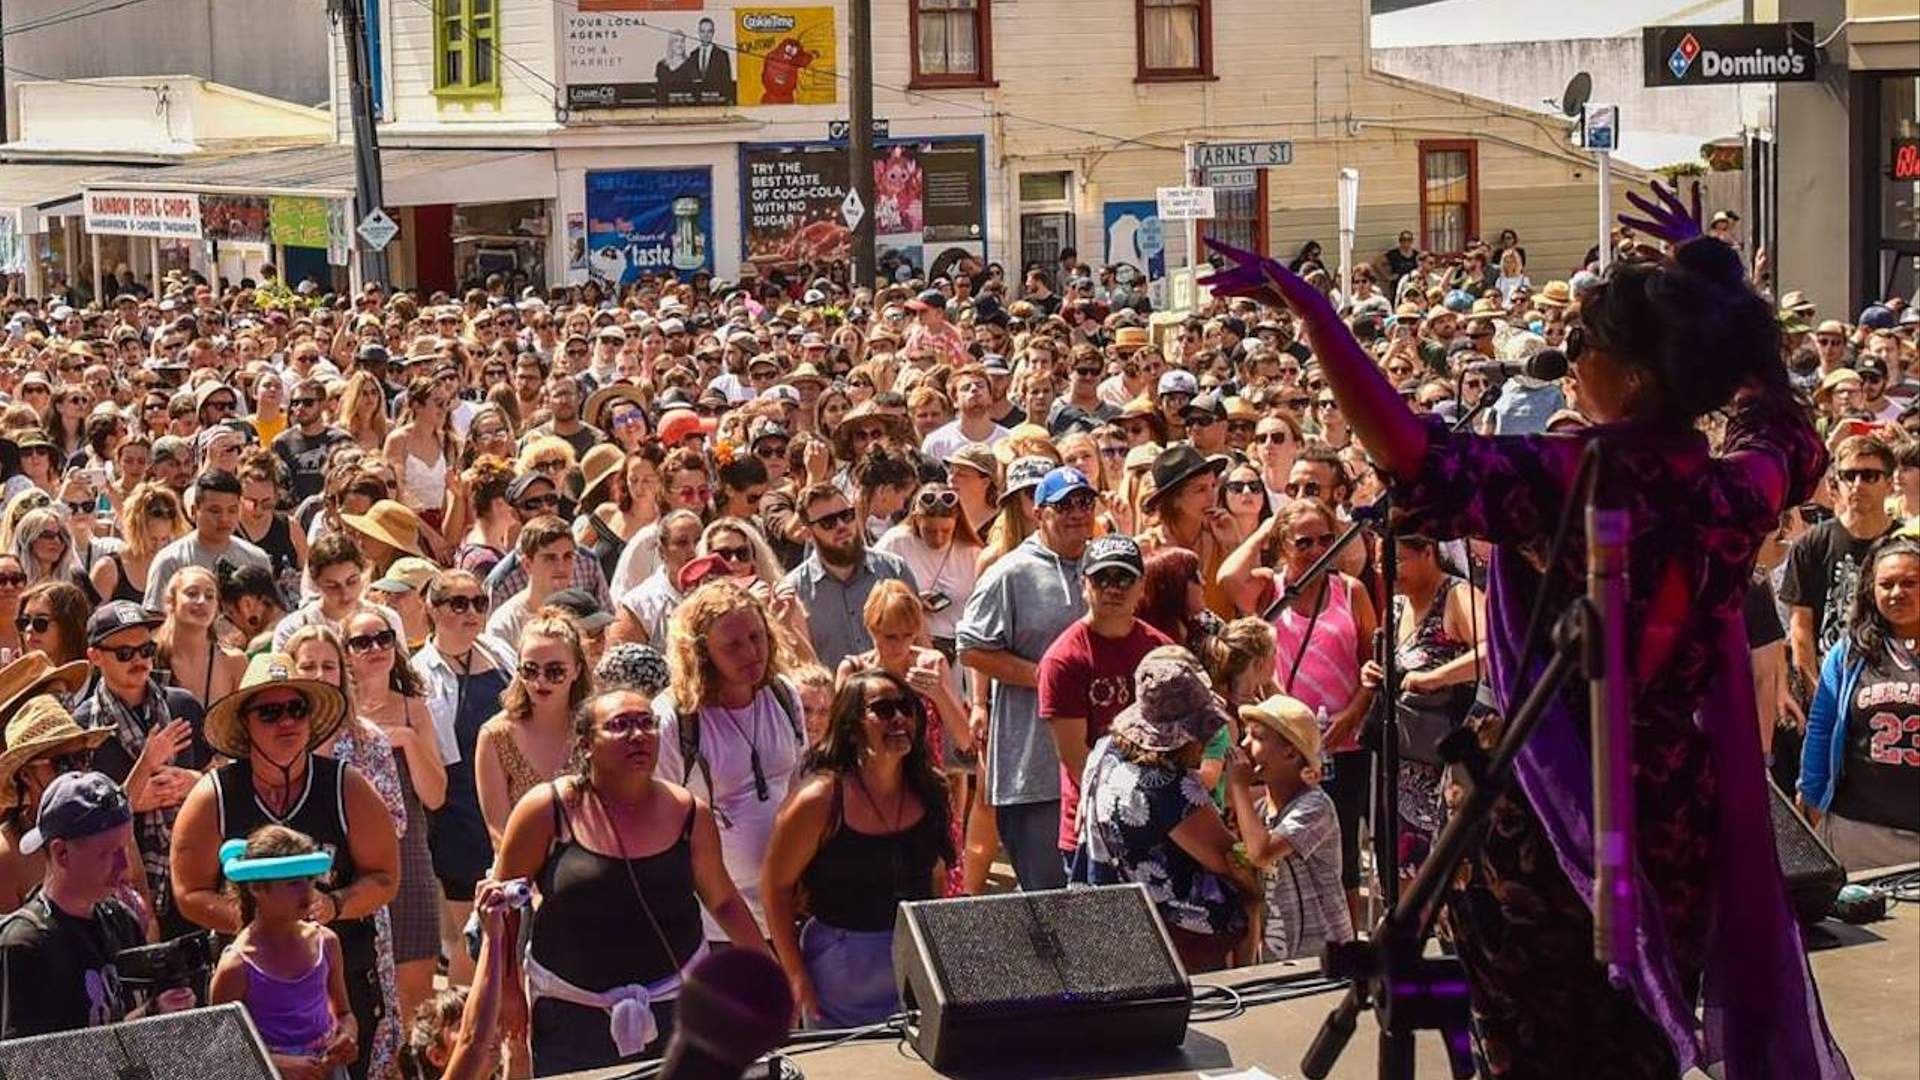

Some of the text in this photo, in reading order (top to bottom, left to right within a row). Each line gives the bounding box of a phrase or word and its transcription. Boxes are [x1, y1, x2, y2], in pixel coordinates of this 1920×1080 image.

[569, 17, 647, 28] YOUR LOCAL
[570, 30, 618, 39] AGENTS
[570, 45, 597, 55] TOM
[570, 57, 623, 67] HARRIET
[1702, 47, 1805, 77] Domino's
[1203, 144, 1287, 165] ARNEY ST
[752, 162, 801, 175] TRY THE
[752, 174, 820, 187] BEST TASTE
[1213, 173, 1252, 184] NO EXIT
[752, 189, 770, 200] OF
[92, 196, 130, 214] RAINBOW
[133, 198, 153, 216] FISH
[163, 199, 191, 218] CHIPS
[753, 201, 806, 213] WITH NO
[753, 214, 794, 226] SUGAR
[632, 243, 671, 266] taste
